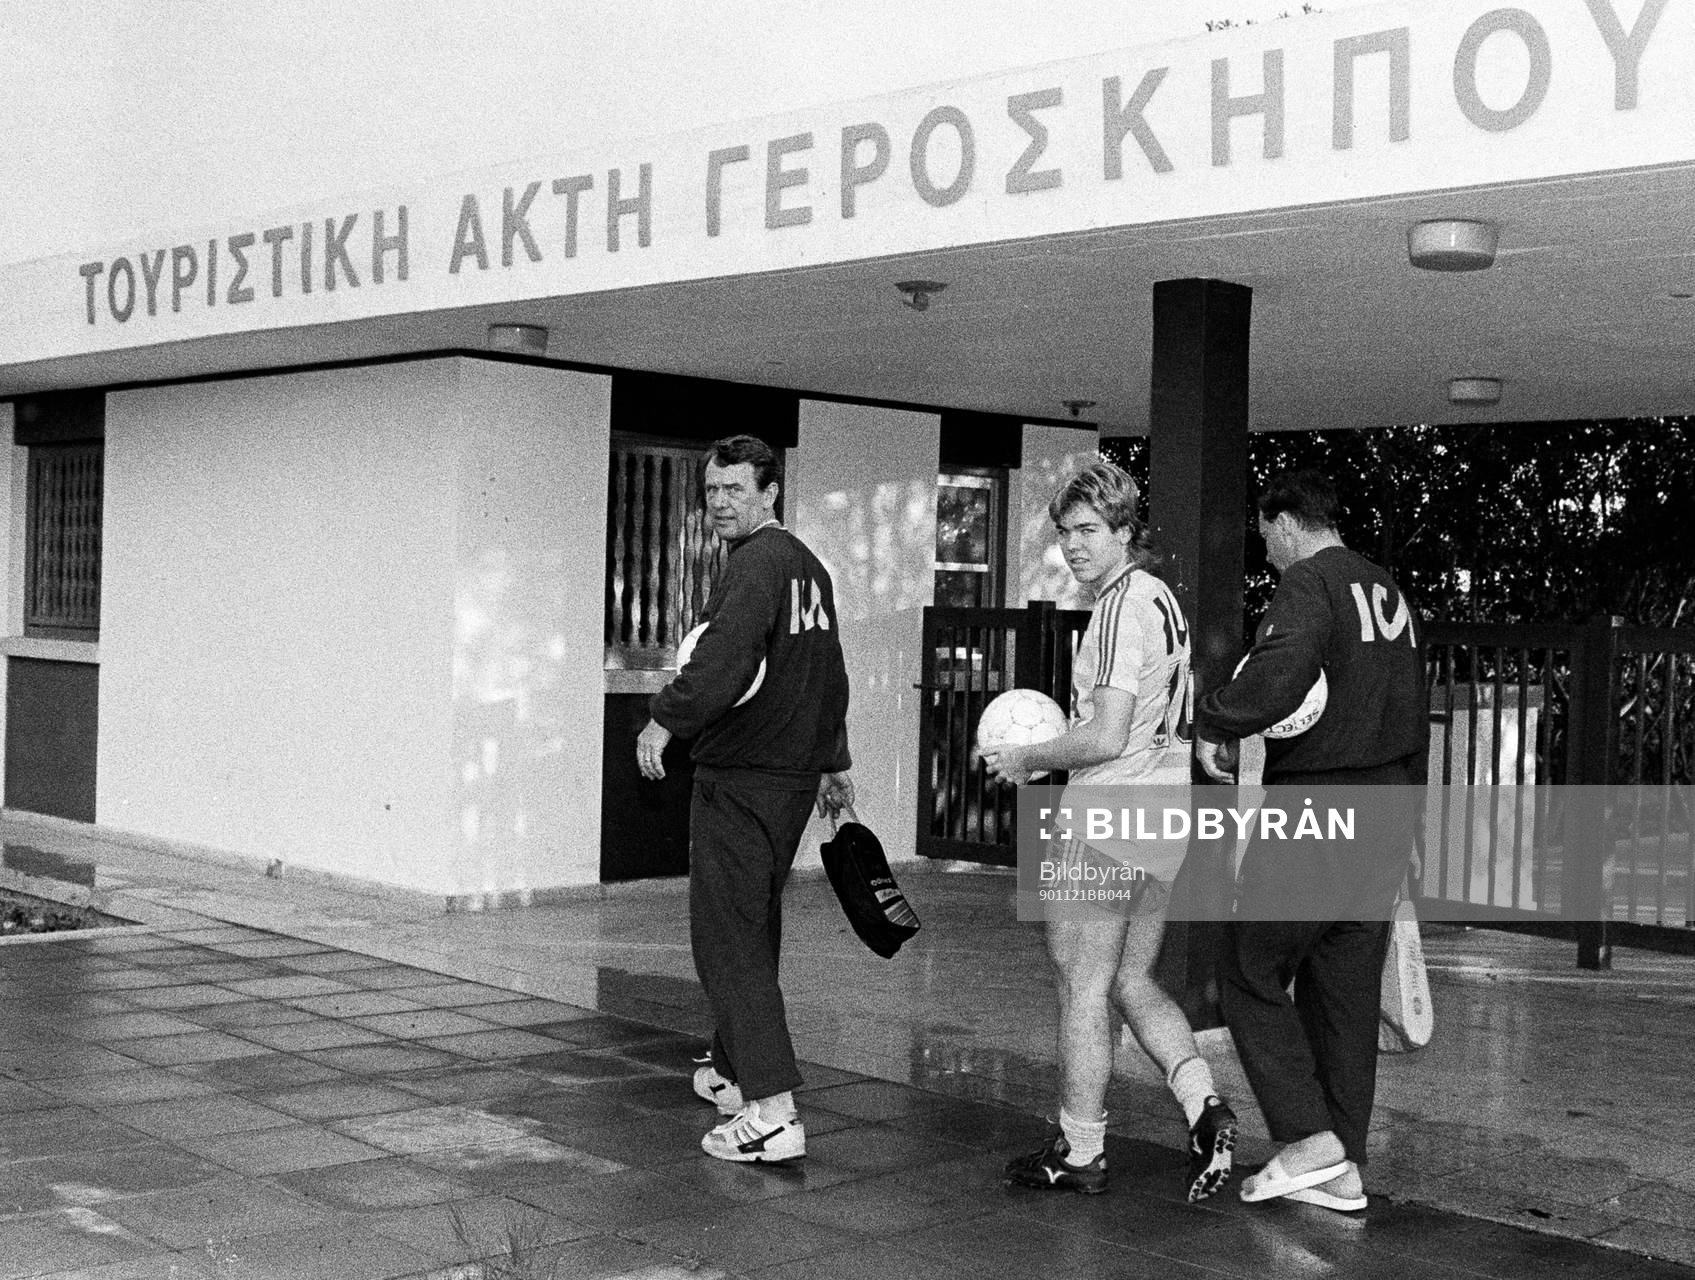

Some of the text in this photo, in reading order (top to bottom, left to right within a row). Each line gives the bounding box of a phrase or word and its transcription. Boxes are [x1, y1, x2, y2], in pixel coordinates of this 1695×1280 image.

[80, 0, 1669, 325] ΤΟΥΡΙΣΤΙΚΗ ΑΚΤΗ ΓΕΡΟΣΚΗΠΟΥ
